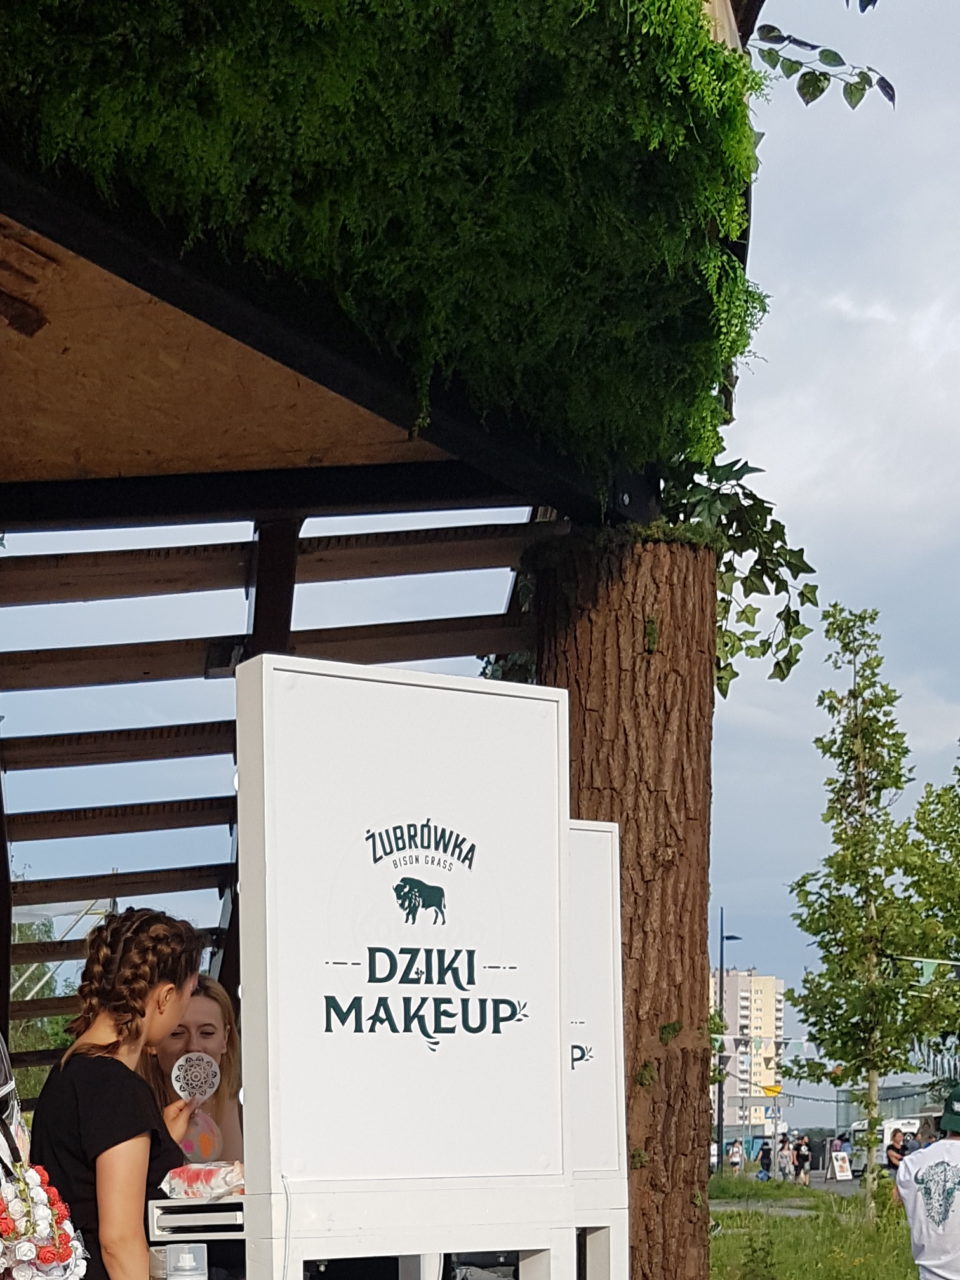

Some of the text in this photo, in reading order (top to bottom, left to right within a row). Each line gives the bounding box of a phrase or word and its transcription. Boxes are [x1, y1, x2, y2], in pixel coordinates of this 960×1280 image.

[364, 818, 476, 870] ŻUBRÓWKA
[392, 854, 454, 872] BISON GRASS
[366, 946, 477, 992] DZIKI
[324, 995, 518, 1040] MAKEUP
